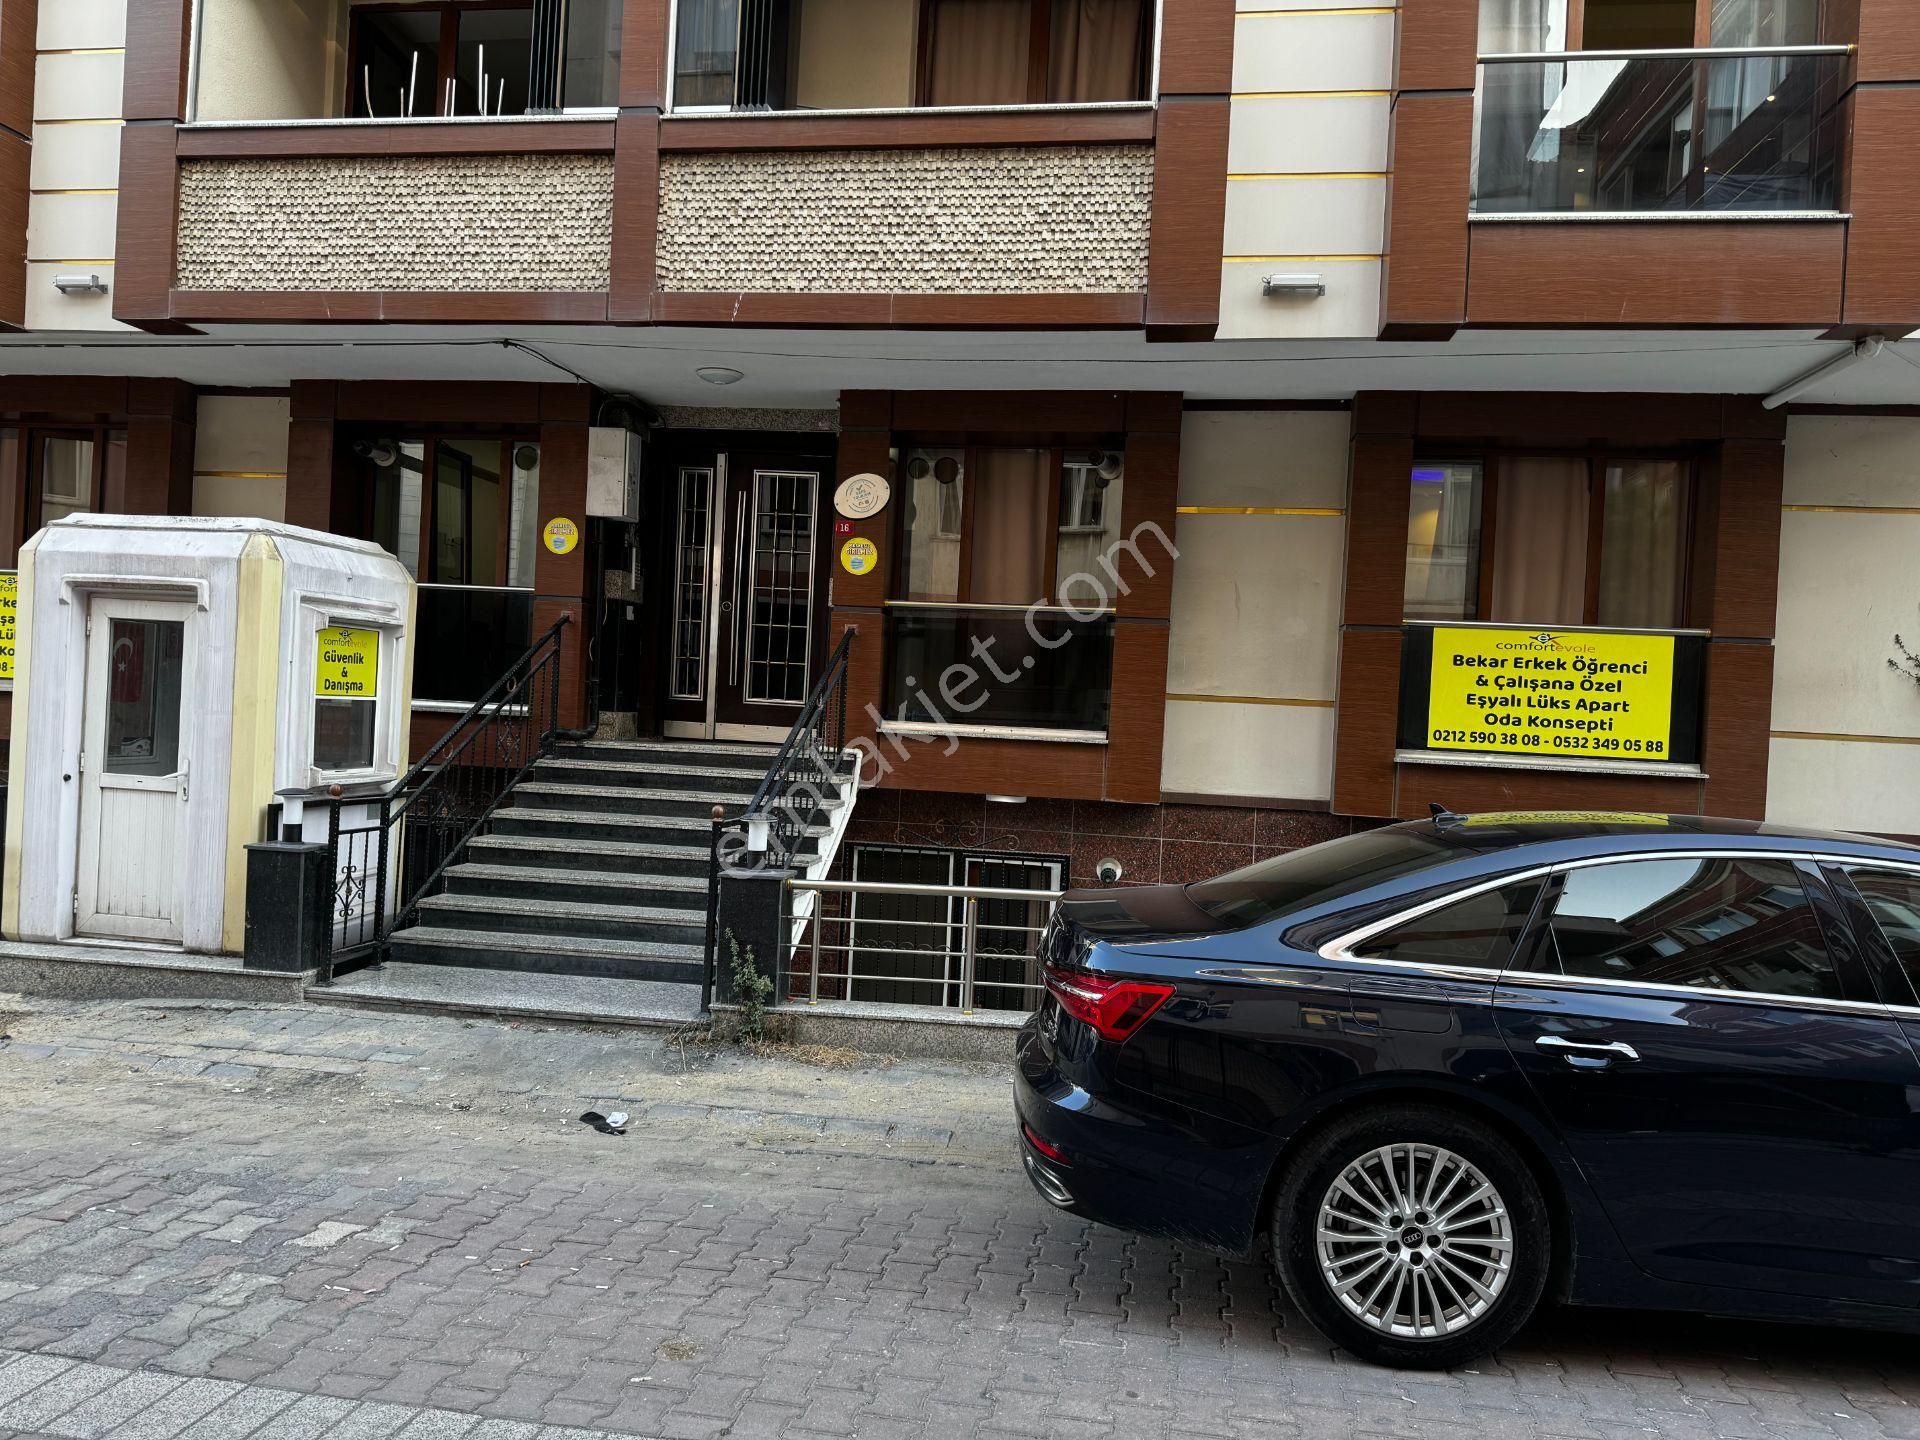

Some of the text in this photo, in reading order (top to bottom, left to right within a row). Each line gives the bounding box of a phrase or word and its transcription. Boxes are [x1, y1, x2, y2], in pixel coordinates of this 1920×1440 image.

[841, 523, 850, 532] 16
[324, 650, 364, 664] Güvenlik
[1452, 654, 1648, 675] Bekar Erkek Öğrenci
[341, 667, 348, 677] &
[324, 679, 363, 693] Danışma
[1475, 675, 1622, 692] & Çalışana Özel
[1466, 693, 1630, 713] Eşyalı Lüks Apart
[1484, 712, 1613, 733] Oda Konsepti
[1433, 729, 1466, 743] 0212
[1469, 731, 1496, 744] 590
[1500, 733, 1517, 745] 38
[1521, 734, 1540, 746] 08
[1553, 735, 1589, 749] 0532
[1592, 738, 1619, 751] 349
[1623, 739, 1642, 752] 05
[1645, 740, 1664, 753] 88
